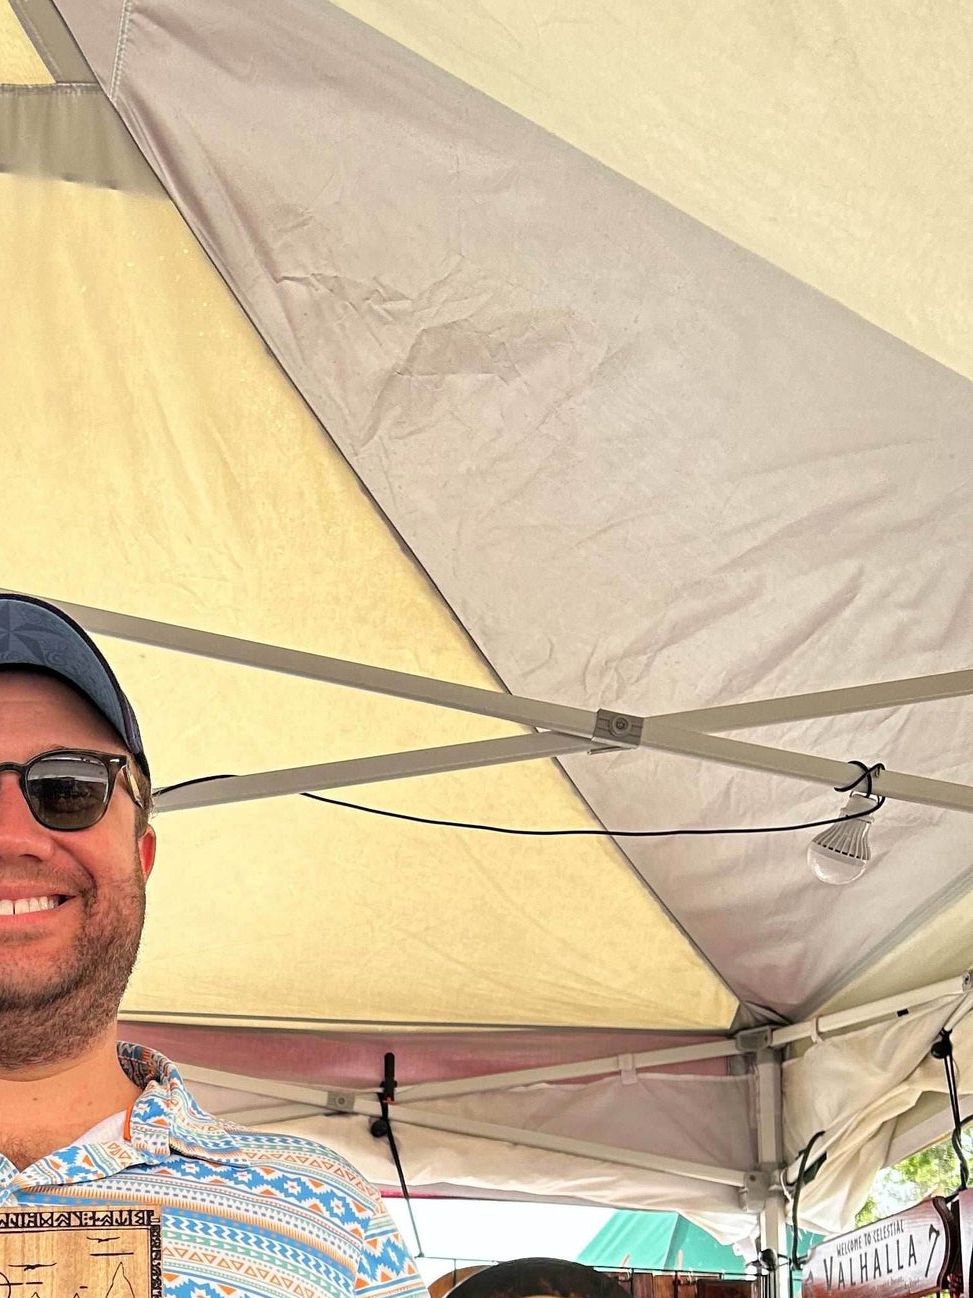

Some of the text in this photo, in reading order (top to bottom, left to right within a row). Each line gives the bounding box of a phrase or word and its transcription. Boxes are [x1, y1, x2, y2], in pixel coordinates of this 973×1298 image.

[836, 1219, 904, 1256] WELCOME TO CELESTIAL
[823, 1234, 917, 1294] VALHALLA
